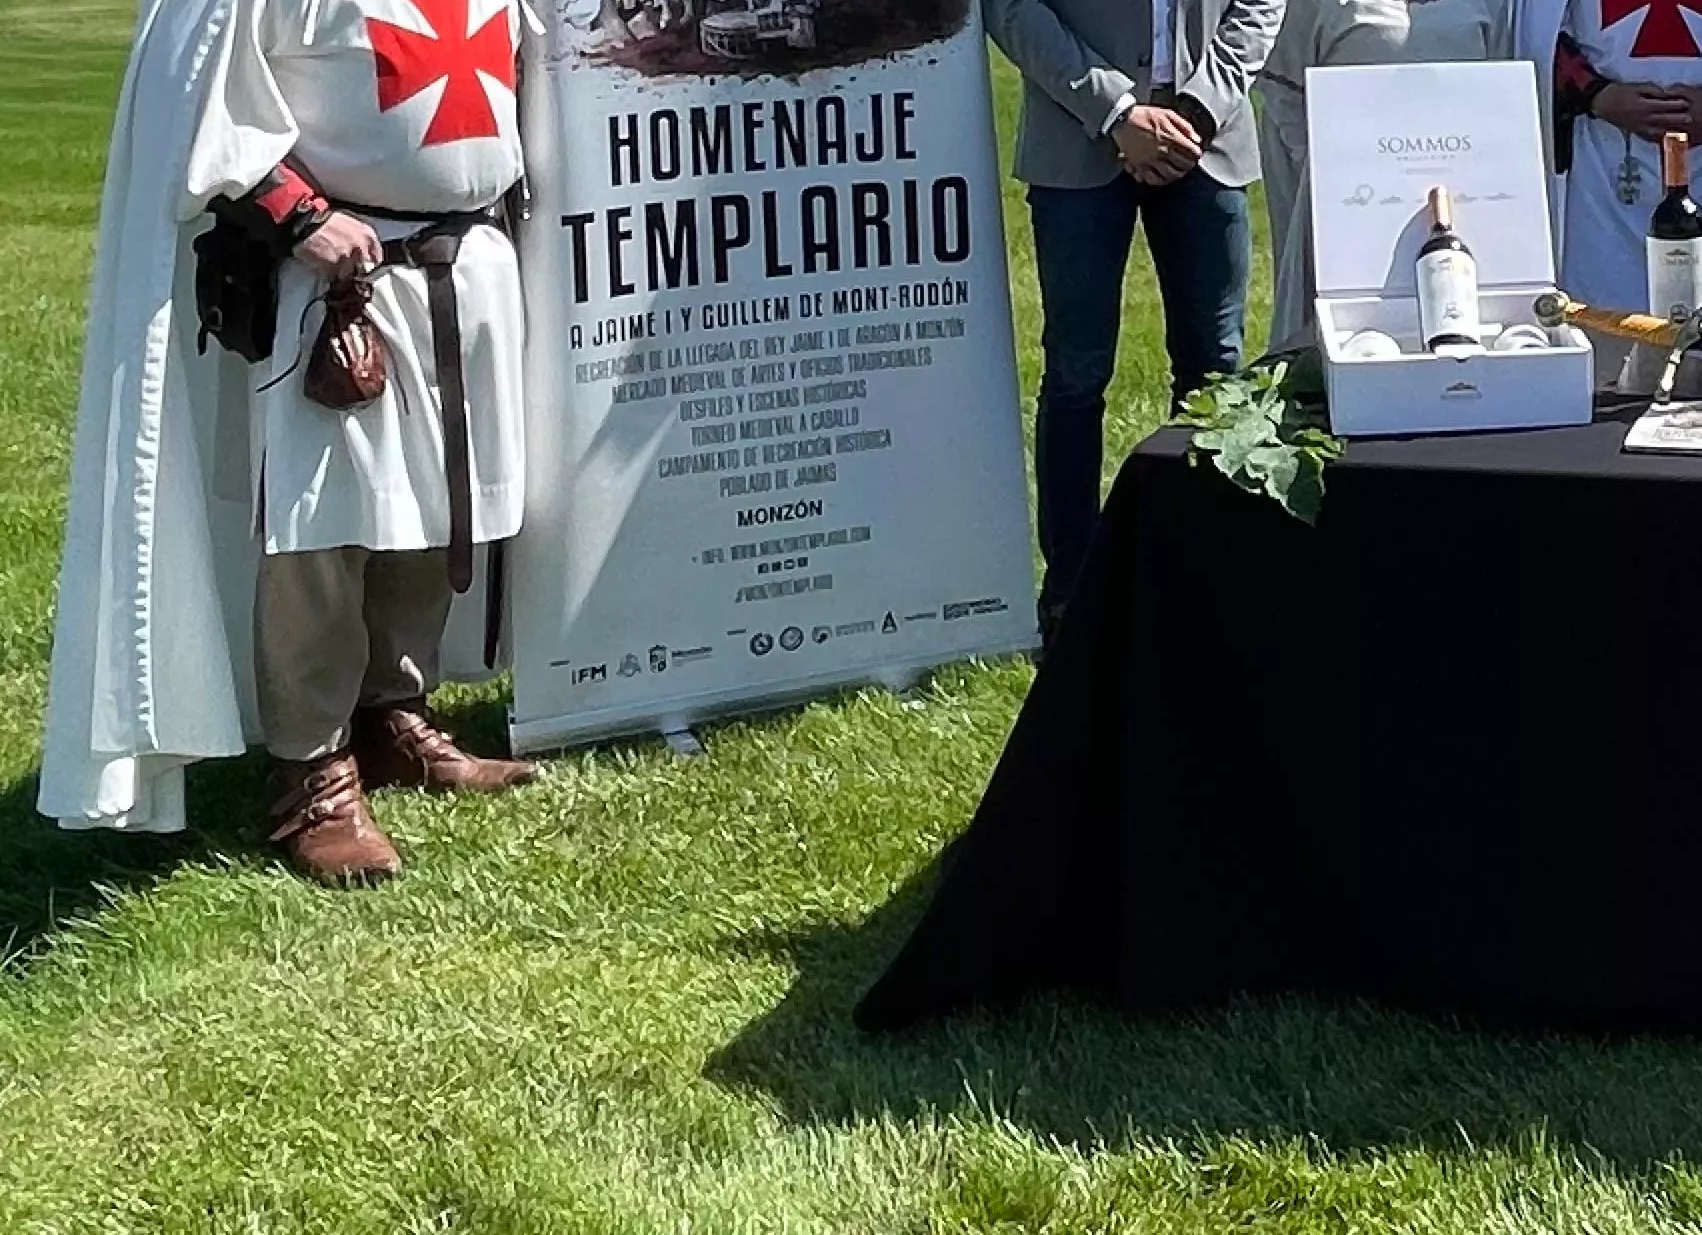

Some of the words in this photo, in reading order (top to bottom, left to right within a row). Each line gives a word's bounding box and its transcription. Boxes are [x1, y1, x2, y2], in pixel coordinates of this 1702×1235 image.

[608, 91, 917, 187] HOMENAJE
[1377, 134, 1472, 154] SOMMOS
[561, 175, 971, 304] TEMPLARIO
[571, 324, 583, 350] A
[592, 311, 656, 347] JAIME
[664, 308, 672, 335] I
[679, 306, 693, 333] Y
[702, 297, 790, 331] GUILLEM
[799, 292, 823, 318] DE
[832, 276, 969, 314] MONT-RODÓN
[789, 360, 797, 380] Y
[736, 497, 823, 527] MONZÓN
